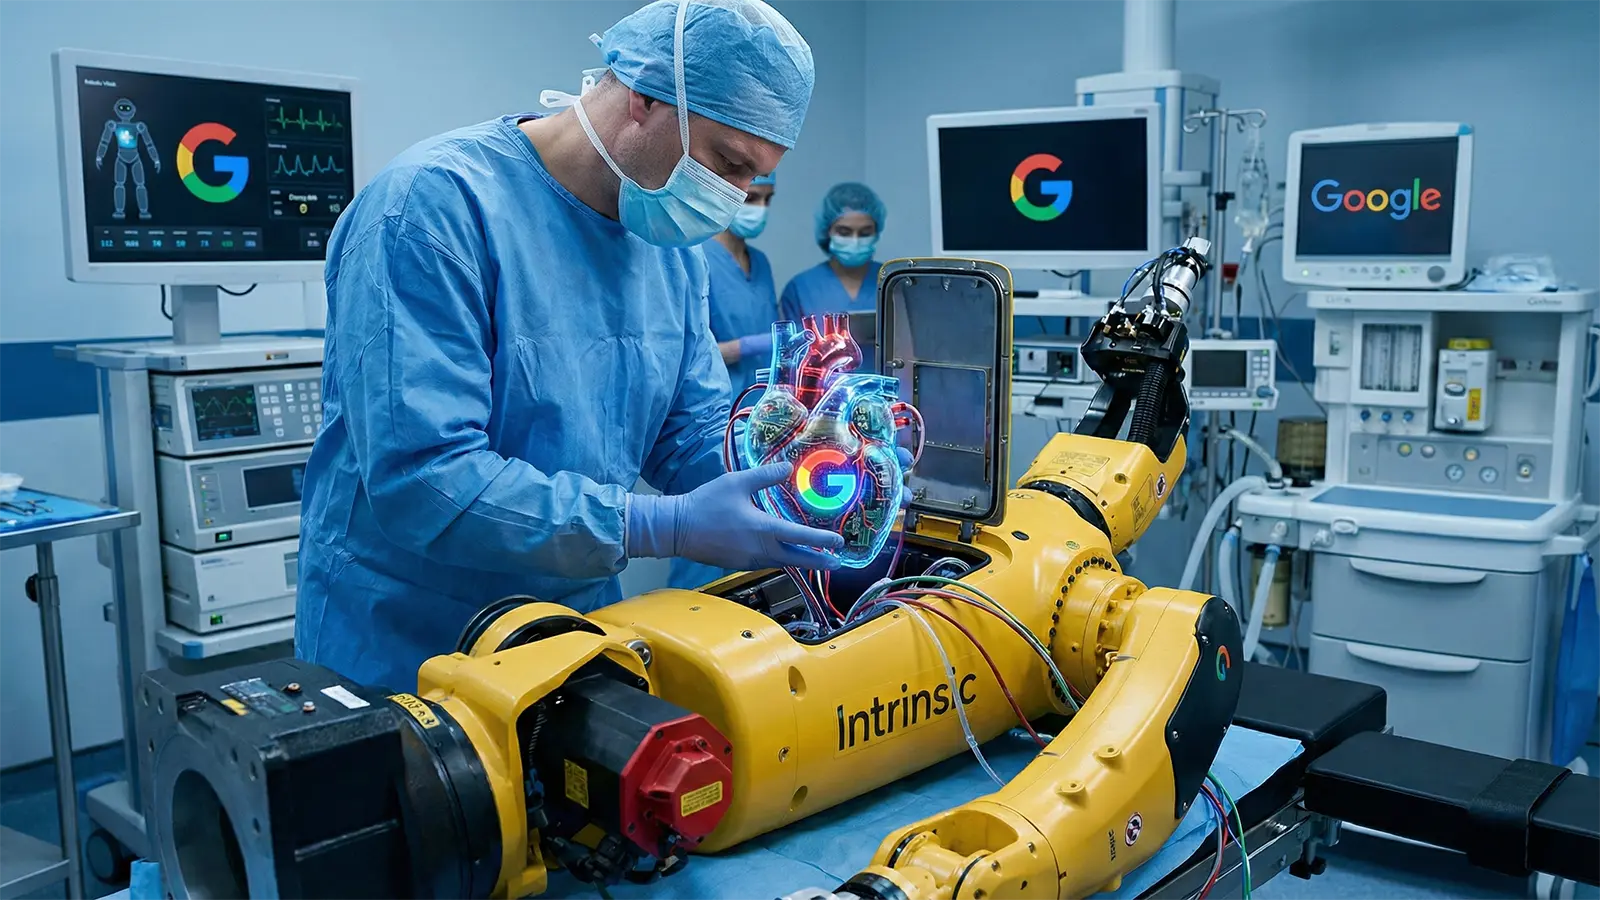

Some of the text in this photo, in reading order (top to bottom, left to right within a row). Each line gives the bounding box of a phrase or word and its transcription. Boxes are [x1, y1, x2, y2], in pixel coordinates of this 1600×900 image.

[177, 122, 249, 203] G
[1010, 153, 1073, 221] G
[1311, 178, 1441, 220] Google
[796, 449, 856, 510] G
